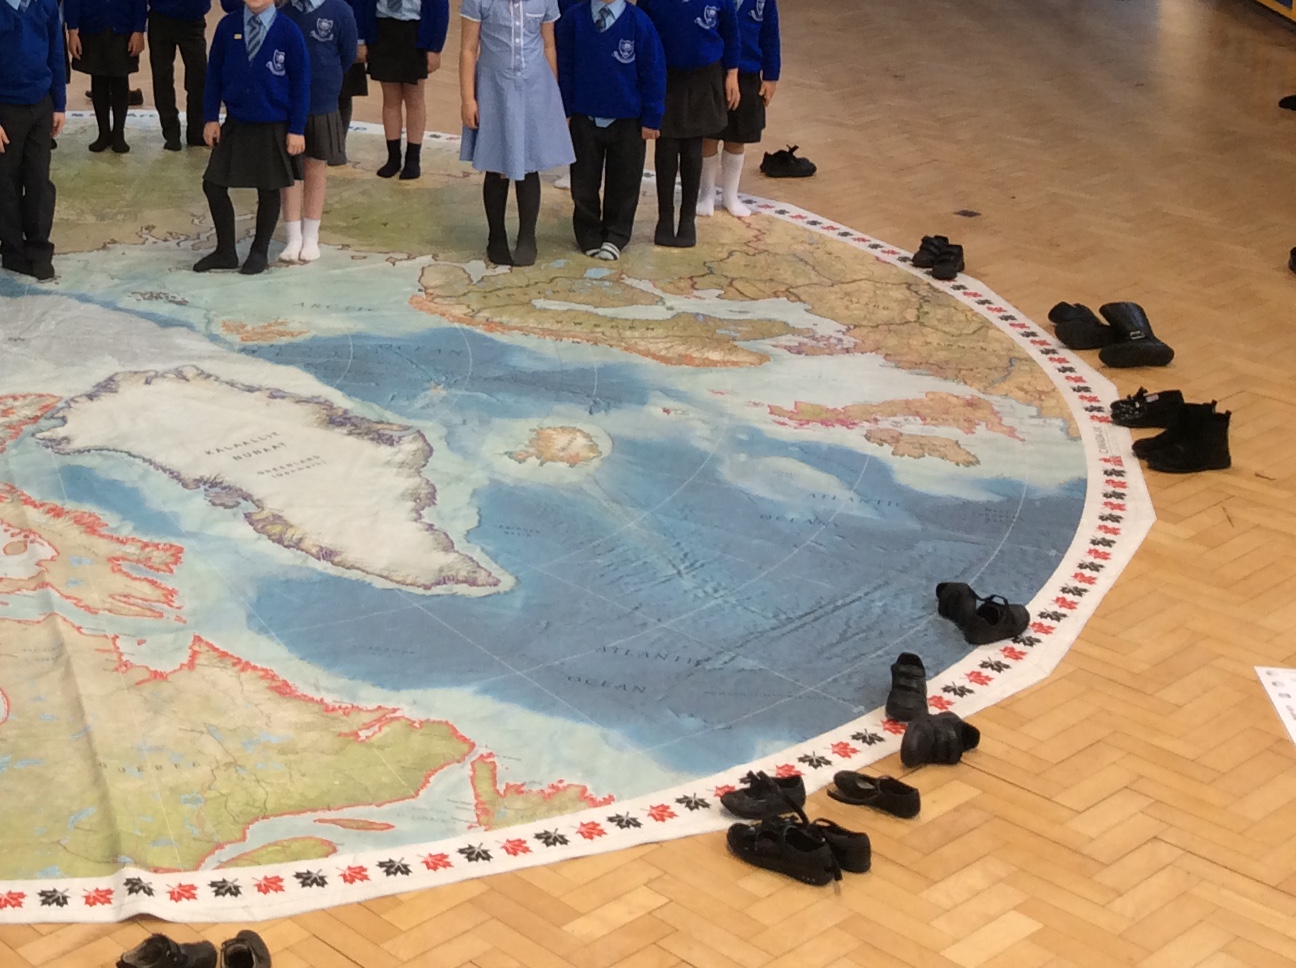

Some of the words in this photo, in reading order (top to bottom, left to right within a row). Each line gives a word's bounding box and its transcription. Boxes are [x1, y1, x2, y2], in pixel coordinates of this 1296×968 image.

[231, 441, 287, 462] NUNAAT
[256, 455, 321, 476] GREENLAND
[567, 675, 647, 695] OCEAN
